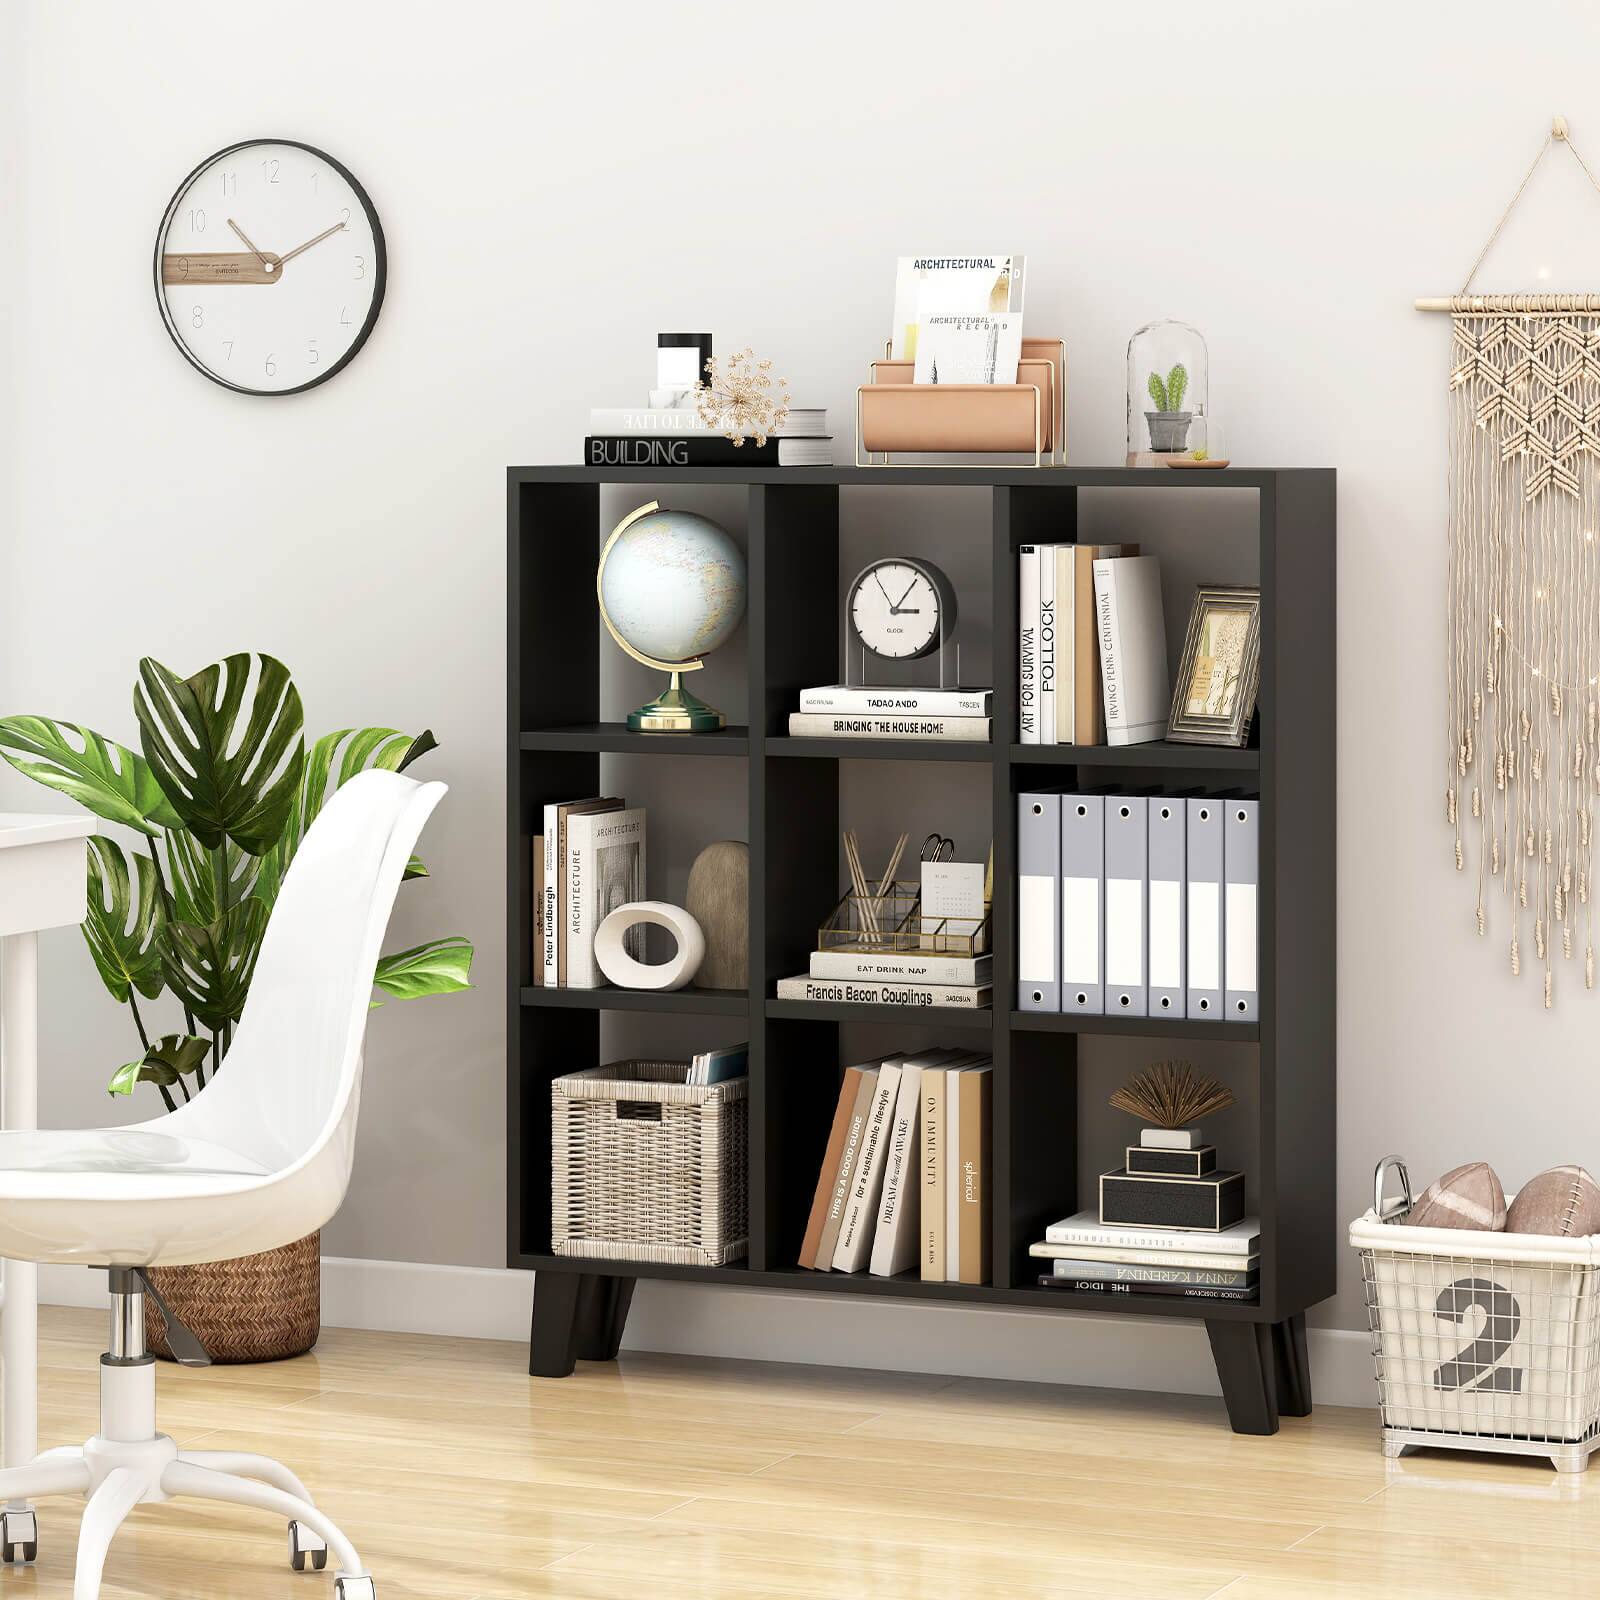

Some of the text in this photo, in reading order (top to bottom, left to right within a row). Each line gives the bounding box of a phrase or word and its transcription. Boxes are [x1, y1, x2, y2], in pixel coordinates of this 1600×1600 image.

[262, 160, 280, 183] 12
[189, 209, 205, 233] 10
[340, 208, 351, 231] 2
[353, 256, 365, 280] 3
[914, 259, 996, 269] ARCHITECTURAL
[192, 306, 203, 328] 8
[340, 306, 352, 328] 4
[222, 341, 234, 360] 7
[308, 340, 318, 364] 5
[266, 353, 276, 376] 6
[624, 414, 657, 429] LIVE
[662, 414, 682, 429] TO
[591, 440, 689, 464] BUILDING
[1042, 600, 1054, 692] POLLOCK
[1099, 592, 1118, 719] IRVING PENN: CENTENNIAL
[1022, 627, 1034, 733] ART FOR SURVIVAL
[867, 699, 918, 708] TADAO ANDO
[834, 720, 944, 734] BRINGING THE HOUSE HOME
[597, 822, 640, 837] ARCHITECTURE
[572, 850, 580, 934] ARCHITECTURE
[546, 886, 555, 966] Peter Lindbergh
[857, 965, 874, 973] EAT
[876, 966, 904, 974] DRINK
[806, 984, 932, 1007] Francis Bacon Couplings
[855, 1184, 864, 1199] for
[863, 1126, 880, 1176] sustainable
[874, 1089, 890, 1124] lifestyle
[895, 1119, 909, 1153] AWAKE
[927, 1097, 936, 1186] ON IMMUNITY
[831, 1197, 842, 1219] THIS
[842, 1147, 854, 1177] GOOD
[850, 1115, 863, 1146] GUIDE
[893, 1152, 902, 1174] world
[964, 1161, 977, 1203] spherical
[883, 1187, 897, 1225] DREAM
[1116, 1268, 1191, 1282] KARENINA
[1193, 1272, 1238, 1285] ANNA
[1074, 1281, 1130, 1293] THE IDIOT
[1434, 1278, 1523, 1394] 2
